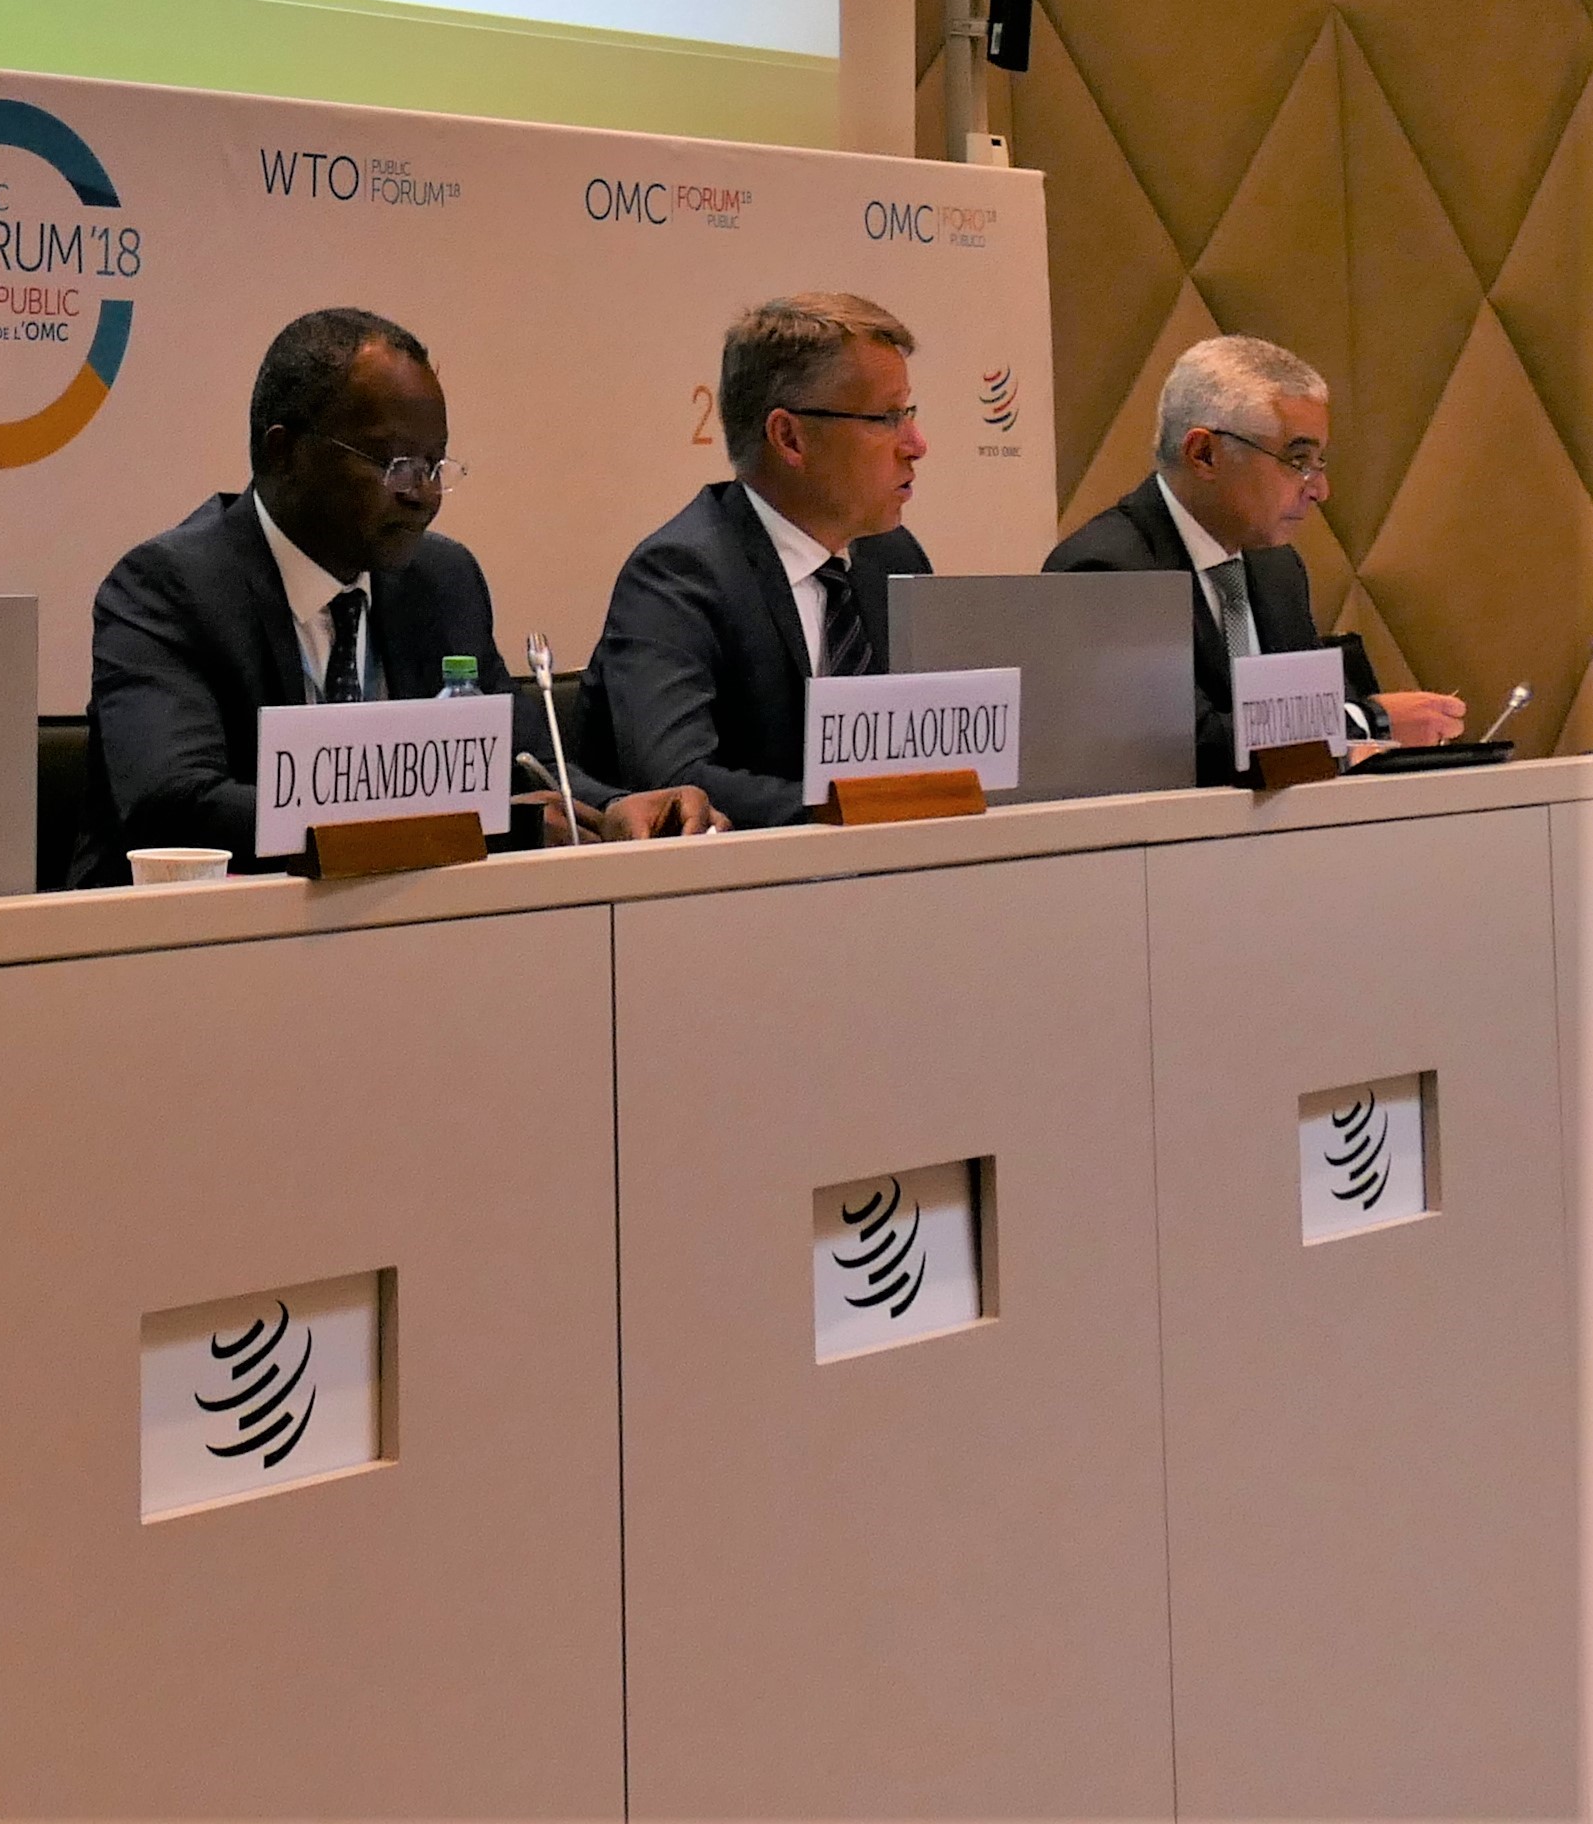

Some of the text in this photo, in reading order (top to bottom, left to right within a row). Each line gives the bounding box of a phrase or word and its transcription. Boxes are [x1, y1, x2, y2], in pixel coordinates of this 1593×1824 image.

[261, 149, 411, 201] WTO PUBLIC
[585, 178, 667, 225] OMC
[864, 201, 935, 243] OMC
[820, 704, 1009, 765] ELOI LAOUROU
[274, 736, 499, 809] D. CHAMBOVEY
